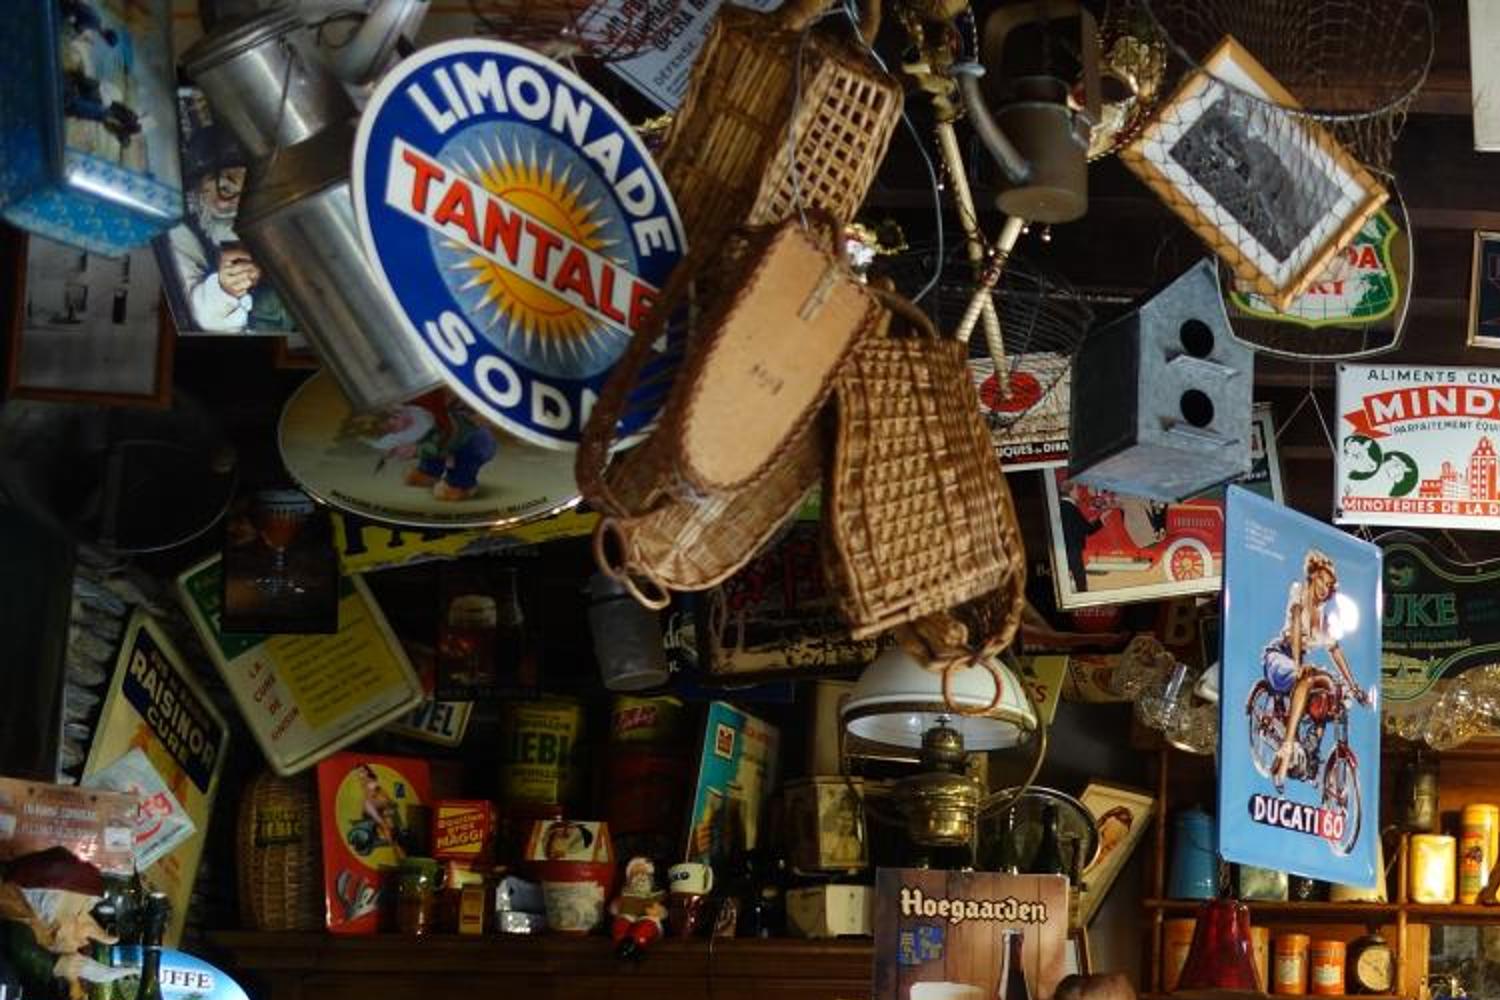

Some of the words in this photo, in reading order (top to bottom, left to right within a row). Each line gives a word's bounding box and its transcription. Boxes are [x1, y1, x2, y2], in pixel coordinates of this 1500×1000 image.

[407, 57, 676, 258] LIMONADE
[1367, 369, 1456, 383] ALIMENTS
[1440, 501, 1459, 516] DE
[1463, 503, 1484, 516] LA
[1254, 795, 1318, 836] DUCATI
[1321, 810, 1344, 839] 60
[900, 888, 1048, 924] Hoegaarden
